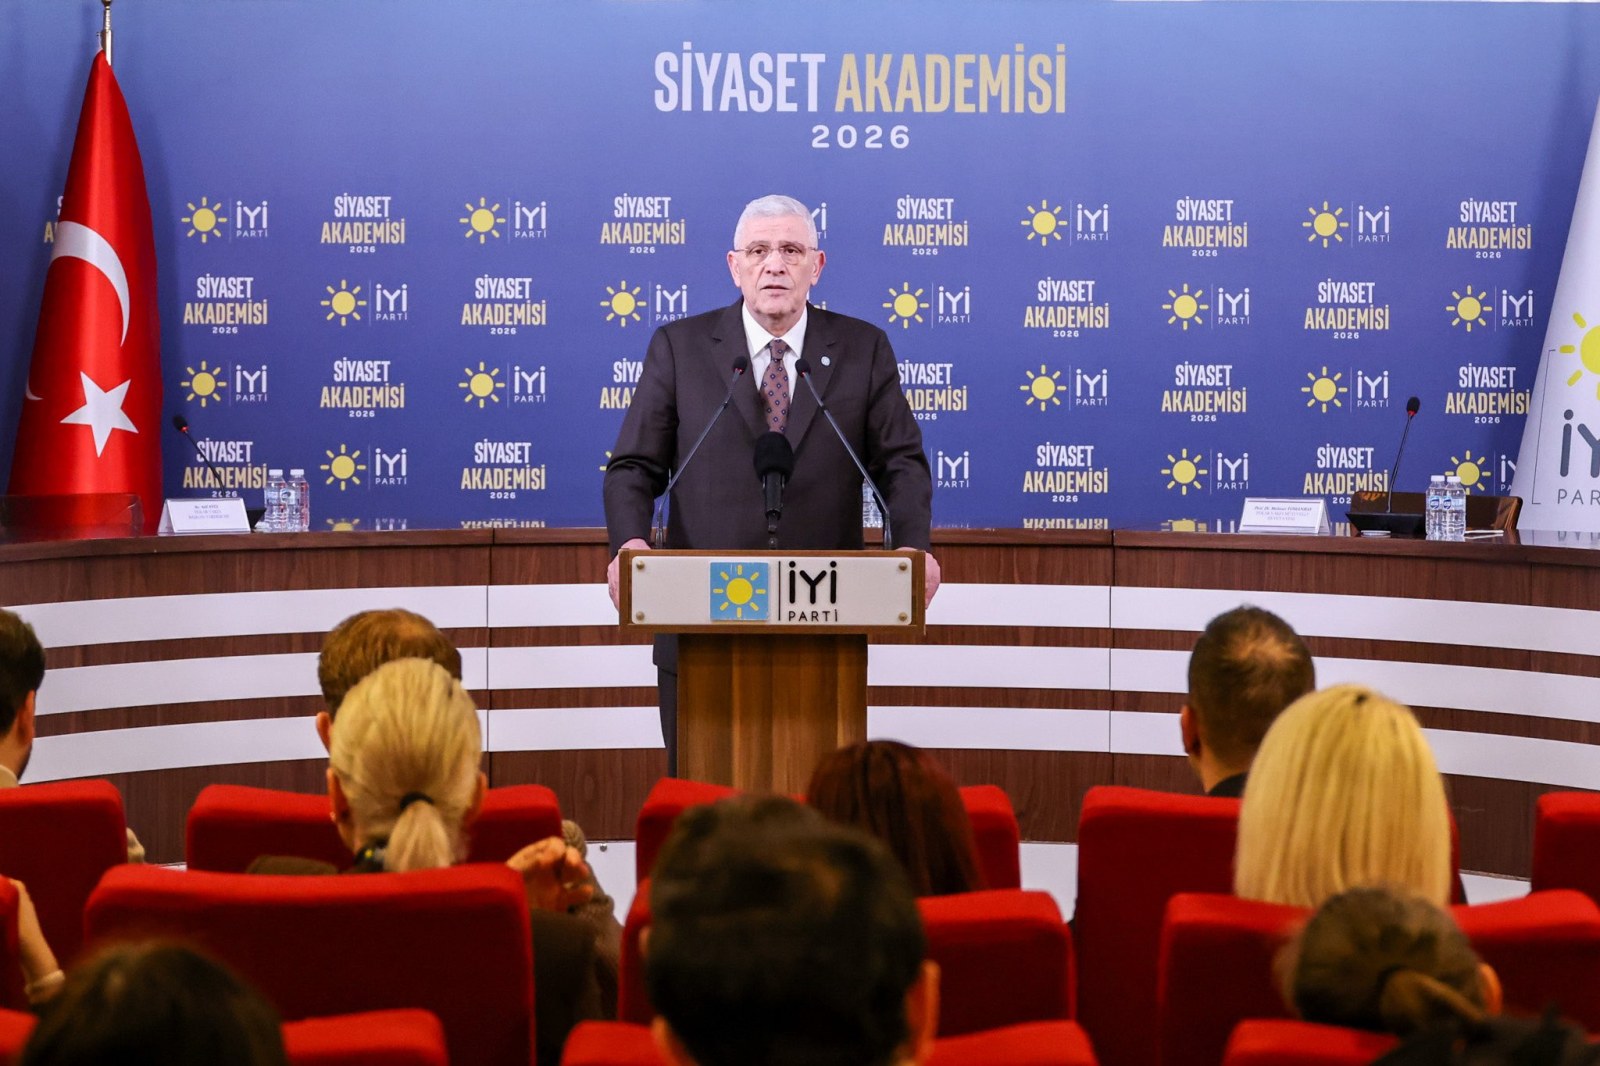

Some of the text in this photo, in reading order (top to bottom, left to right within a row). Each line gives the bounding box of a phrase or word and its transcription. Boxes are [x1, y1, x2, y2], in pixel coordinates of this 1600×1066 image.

[654, 41, 1066, 113] SİYASET AKADEMİSİ
[811, 124, 910, 149] 2026
[237, 201, 267, 228] İYİ
[335, 193, 391, 217] SİYASET
[515, 201, 546, 229] İYİ
[615, 193, 671, 217] SİYASET
[897, 195, 953, 219] SİYASET
[1177, 196, 1233, 221] SİYASET
[1461, 198, 1517, 222] SİYASET
[1078, 204, 1108, 232] İYİ
[1359, 206, 1389, 233] İYİ
[237, 229, 267, 237] PARTİ
[321, 219, 404, 243] AKADEMİSİ
[601, 219, 684, 243] AKADEMİSİ
[884, 221, 967, 245] AKADEMİSİ
[1163, 222, 1247, 247] AKADEMİSİ
[1359, 234, 1389, 242] PARTİ
[1447, 224, 1530, 248] AKADEMİSİ
[349, 245, 376, 253] 2026
[629, 245, 656, 253] 2026
[912, 247, 939, 255] 2026
[1191, 249, 1218, 257] 2026
[1475, 250, 1502, 258] 2026
[198, 274, 253, 298] SİYASET
[376, 284, 407, 311] İYİ
[476, 275, 532, 298] SİYASET
[1038, 277, 1094, 301] SİYASET
[1319, 279, 1375, 303] SİYASET
[656, 285, 687, 312] İYİ
[939, 286, 969, 314] İYİ
[1219, 288, 1249, 315] İYİ
[1502, 290, 1533, 317] İYİ
[184, 300, 267, 324] AKADEMİSİ
[376, 312, 407, 320] PARTİ
[462, 300, 545, 324] AKADEMİSİ
[939, 315, 969, 323] PARTİ
[1025, 303, 1108, 328] AKADEMİSİ
[1305, 305, 1388, 329] AKADEMİSİ
[212, 326, 239, 334] 2026
[490, 326, 517, 334] 2026
[1053, 330, 1080, 338] 2026
[1333, 331, 1360, 339] 2026
[236, 365, 267, 393] İYİ
[334, 357, 390, 381] SİYASET
[515, 366, 545, 394] İYİ
[897, 360, 953, 385] SİYASET
[1176, 362, 1232, 386] SİYASET
[1459, 363, 1515, 387] SİYASET
[321, 383, 404, 407] AKADEMİSİ
[1076, 369, 1107, 397] İYİ
[1358, 371, 1388, 398] İYİ
[906, 386, 967, 411] ADEMİSİ
[1162, 388, 1246, 412] AKADEMİSİ
[1358, 399, 1388, 407] PARTİ
[1446, 390, 1529, 413] AKADEMİSİ
[349, 409, 376, 417] 2026
[1190, 414, 1217, 422] 2026
[1474, 415, 1501, 423] 2026
[196, 437, 253, 462] SİYASET
[475, 439, 531, 463] SİYASET
[1037, 442, 1093, 466] SİYASET
[1317, 444, 1373, 468] SİYASET
[376, 448, 406, 476] İYİ
[938, 451, 969, 479] İYİ
[1218, 453, 1248, 481] İYİ
[183, 463, 267, 488] AKADEMİSİ
[462, 465, 544, 489] AKADEMİSİ
[1024, 468, 1107, 492] AKADEMİSİ
[1304, 470, 1387, 494] AKADEMİSİ
[490, 491, 517, 499] 2026
[1052, 494, 1079, 502] 2026
[788, 560, 837, 604] İYİ
[788, 609, 838, 622] PARTİ
